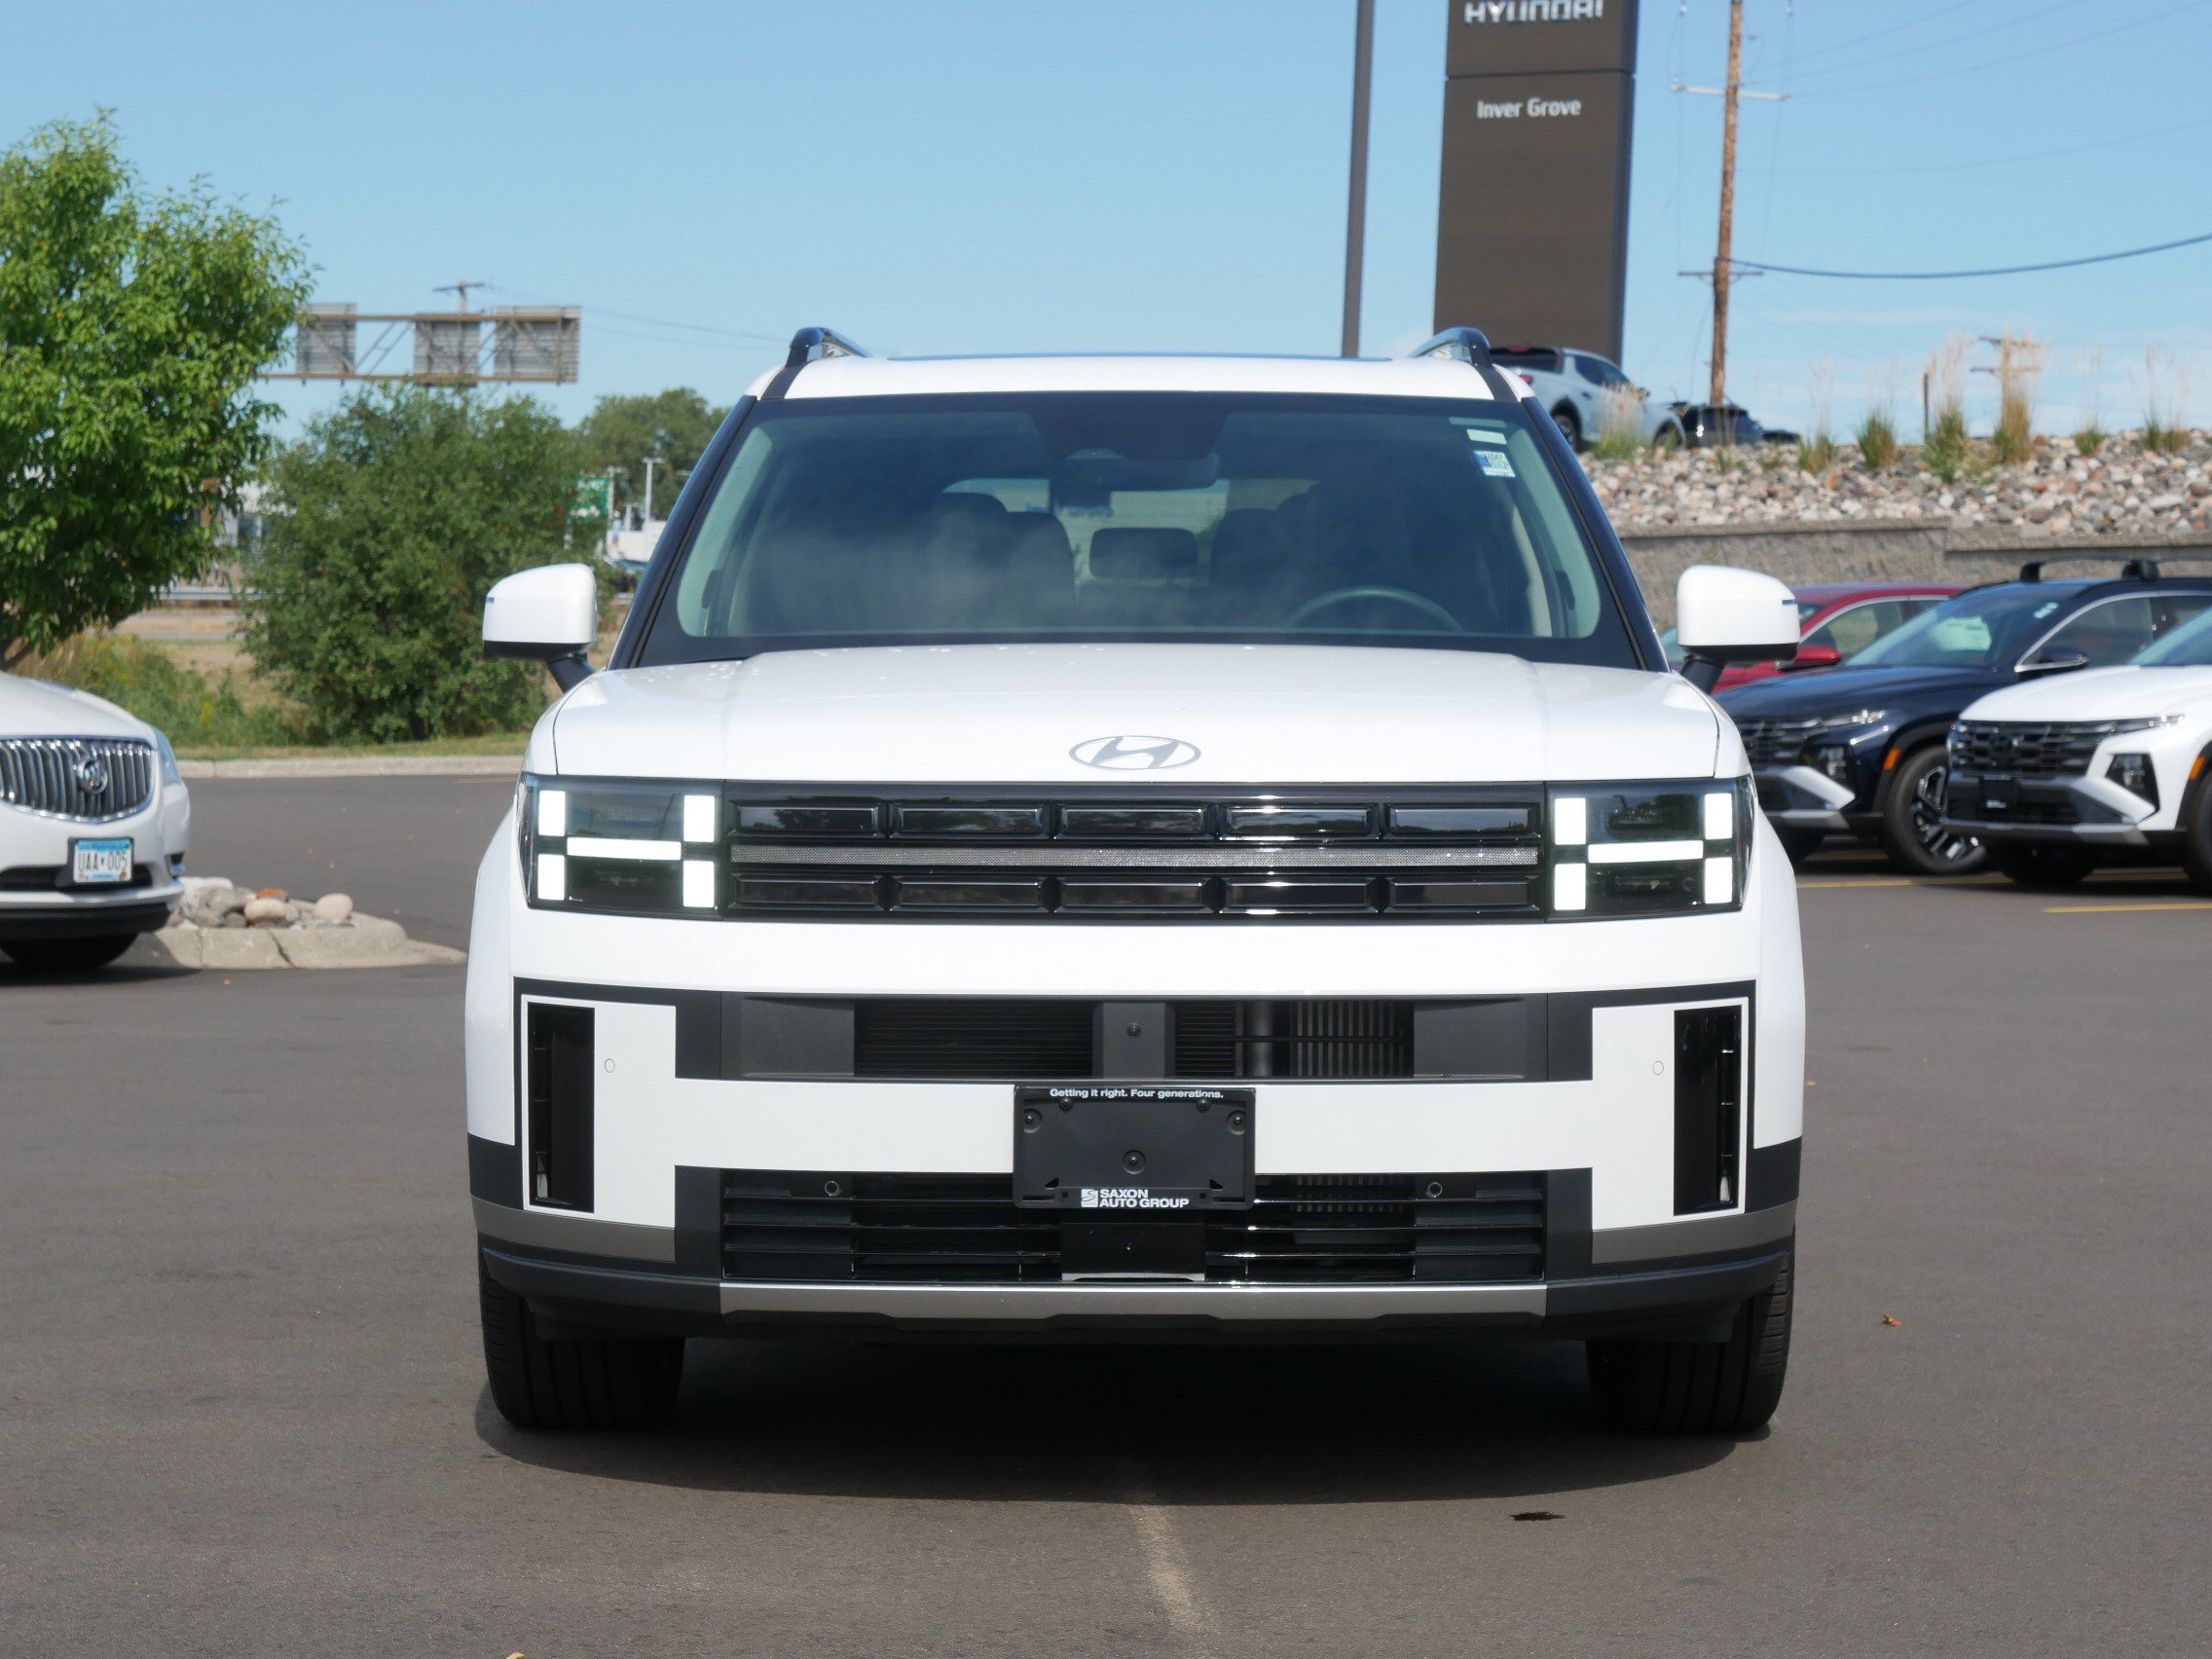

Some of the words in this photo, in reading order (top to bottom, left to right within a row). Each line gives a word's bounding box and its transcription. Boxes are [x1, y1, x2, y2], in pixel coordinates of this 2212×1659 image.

[1464, 0, 1604, 23] HYUNDAI
[1477, 99, 1523, 119] Inver
[1527, 96, 1582, 117] Grove
[1050, 1088, 1088, 1099] Getting
[1090, 1088, 1098, 1097] it
[1100, 1088, 1128, 1099] right.
[1130, 1088, 1156, 1097] Four
[1157, 1089, 1224, 1099] generations.
[1099, 1189, 1149, 1198] SAXON
[1099, 1198, 1138, 1208] AUTO
[1139, 1198, 1190, 1208] GROUP
